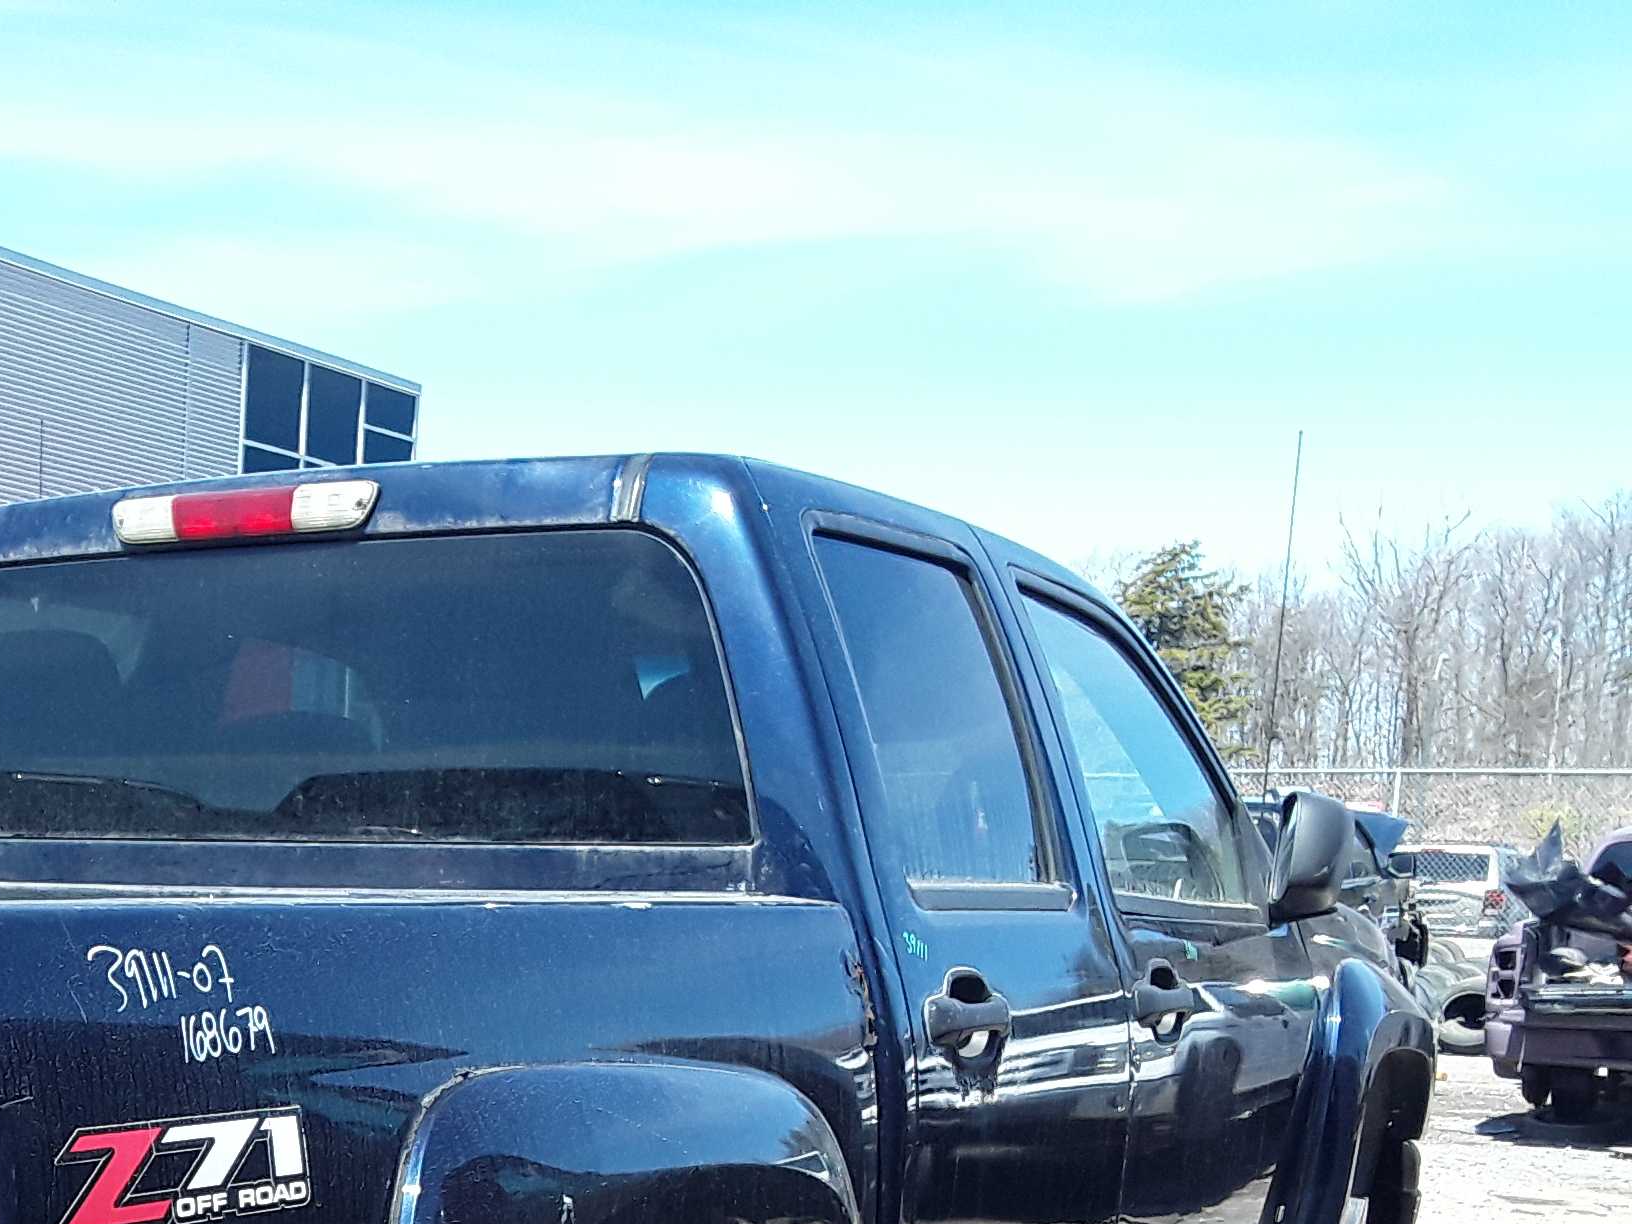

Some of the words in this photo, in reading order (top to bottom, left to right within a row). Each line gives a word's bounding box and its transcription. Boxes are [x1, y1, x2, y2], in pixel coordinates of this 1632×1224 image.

[180, 1004, 276, 1064] 168679
[175, 1190, 228, 1219] OFF
[237, 1180, 308, 1209] ROAD
